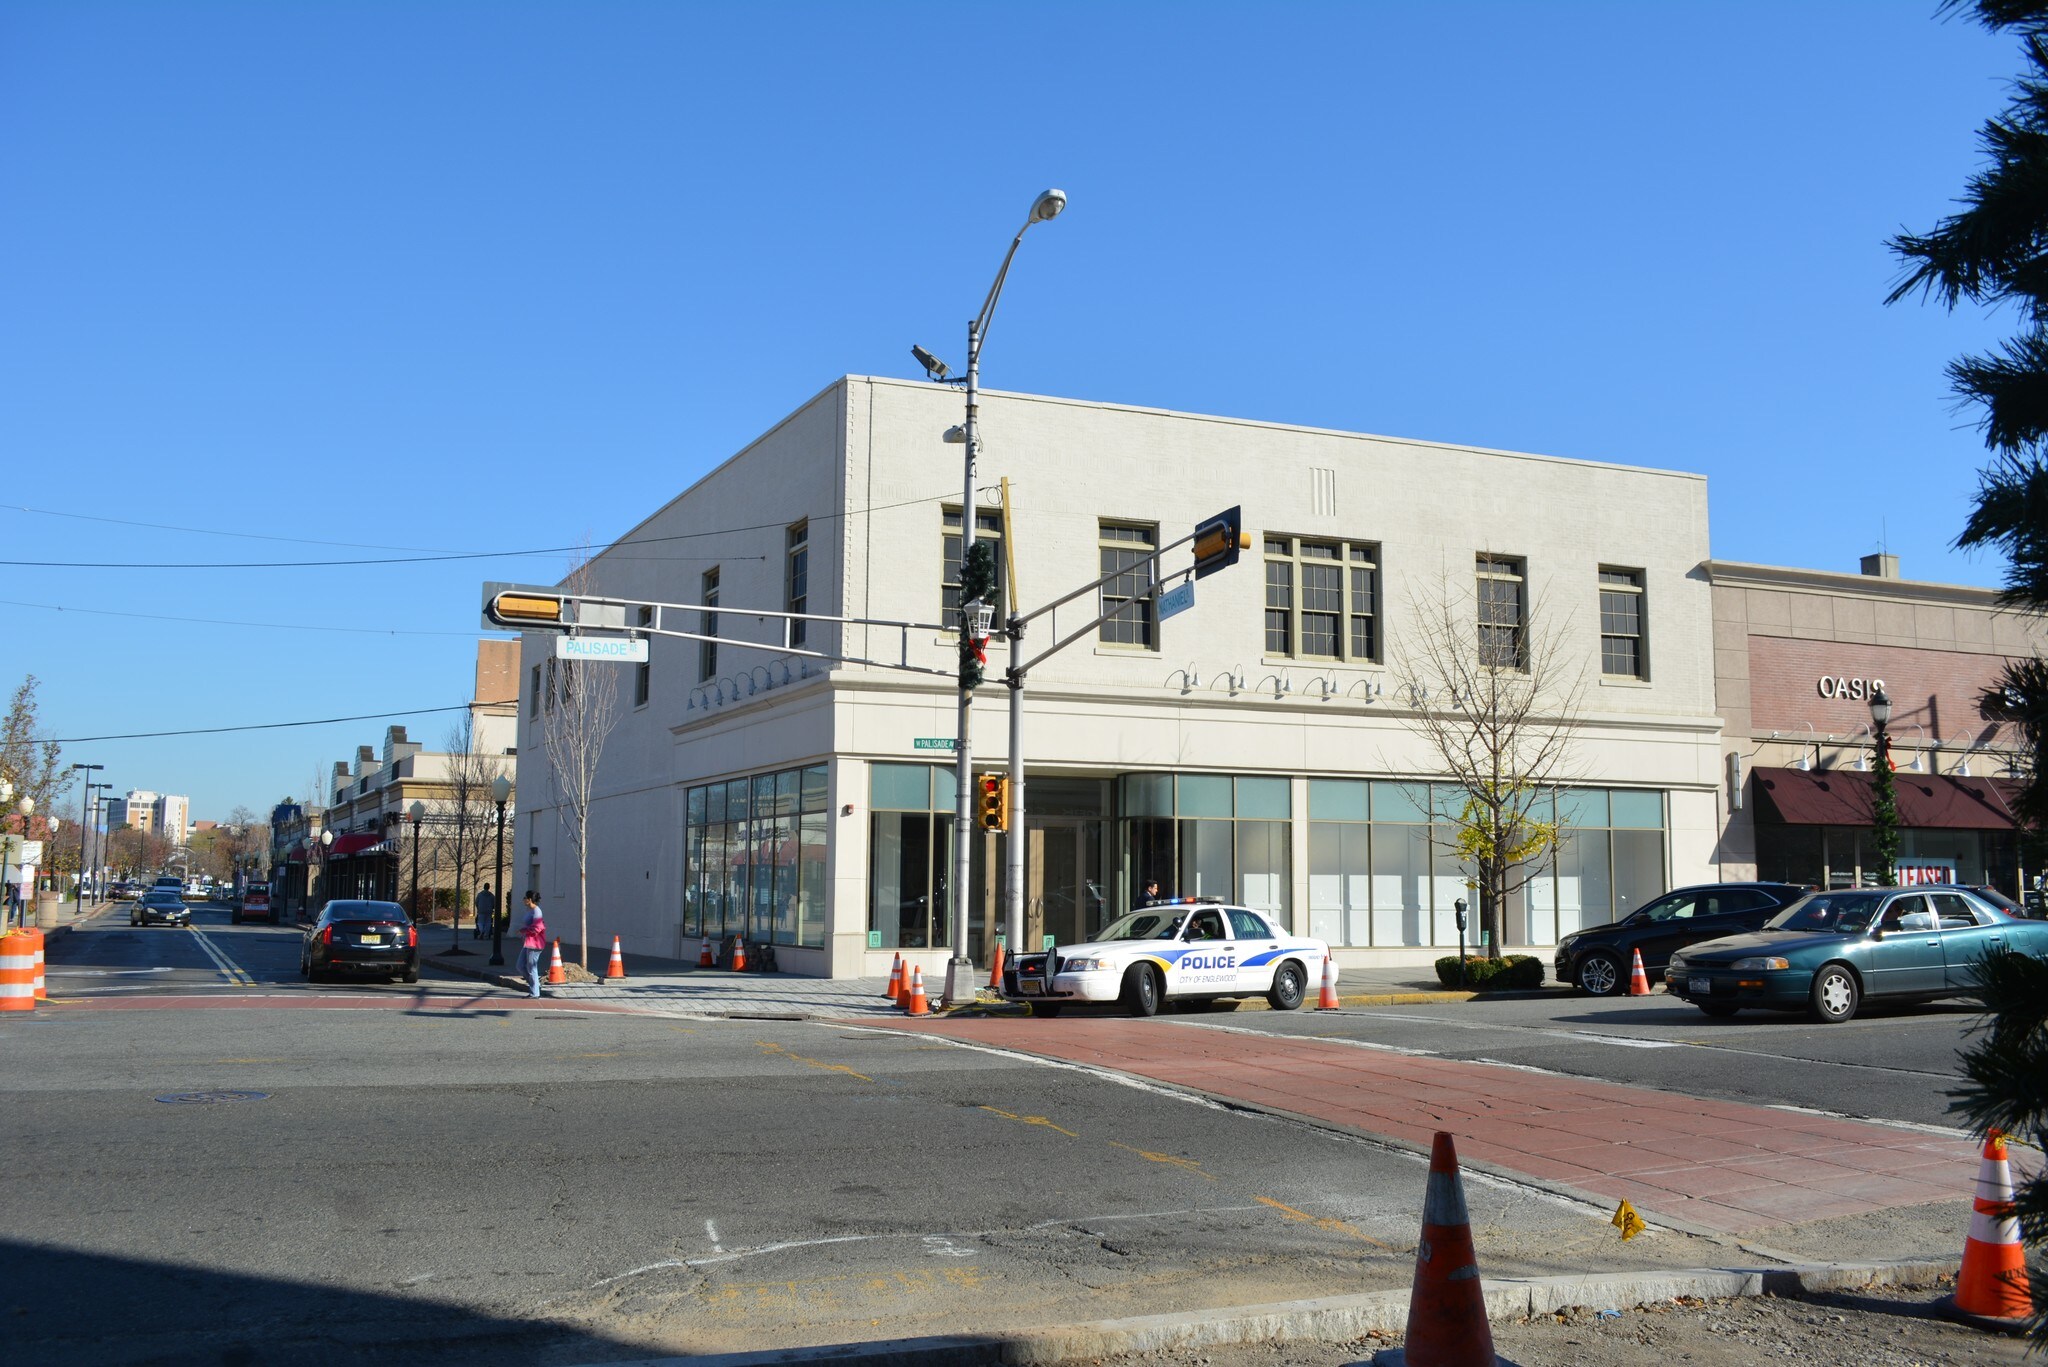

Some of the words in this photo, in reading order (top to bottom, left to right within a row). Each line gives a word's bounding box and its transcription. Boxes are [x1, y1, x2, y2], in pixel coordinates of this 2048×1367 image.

[566, 641, 627, 655] PALISADE
[1819, 675, 1886, 699] OASIS
[921, 740, 949, 748] PALISADE
[1181, 956, 1236, 970] POLICE
[1179, 976, 1193, 984] CITY
[1202, 974, 1236, 983] ENGLEWOOD
